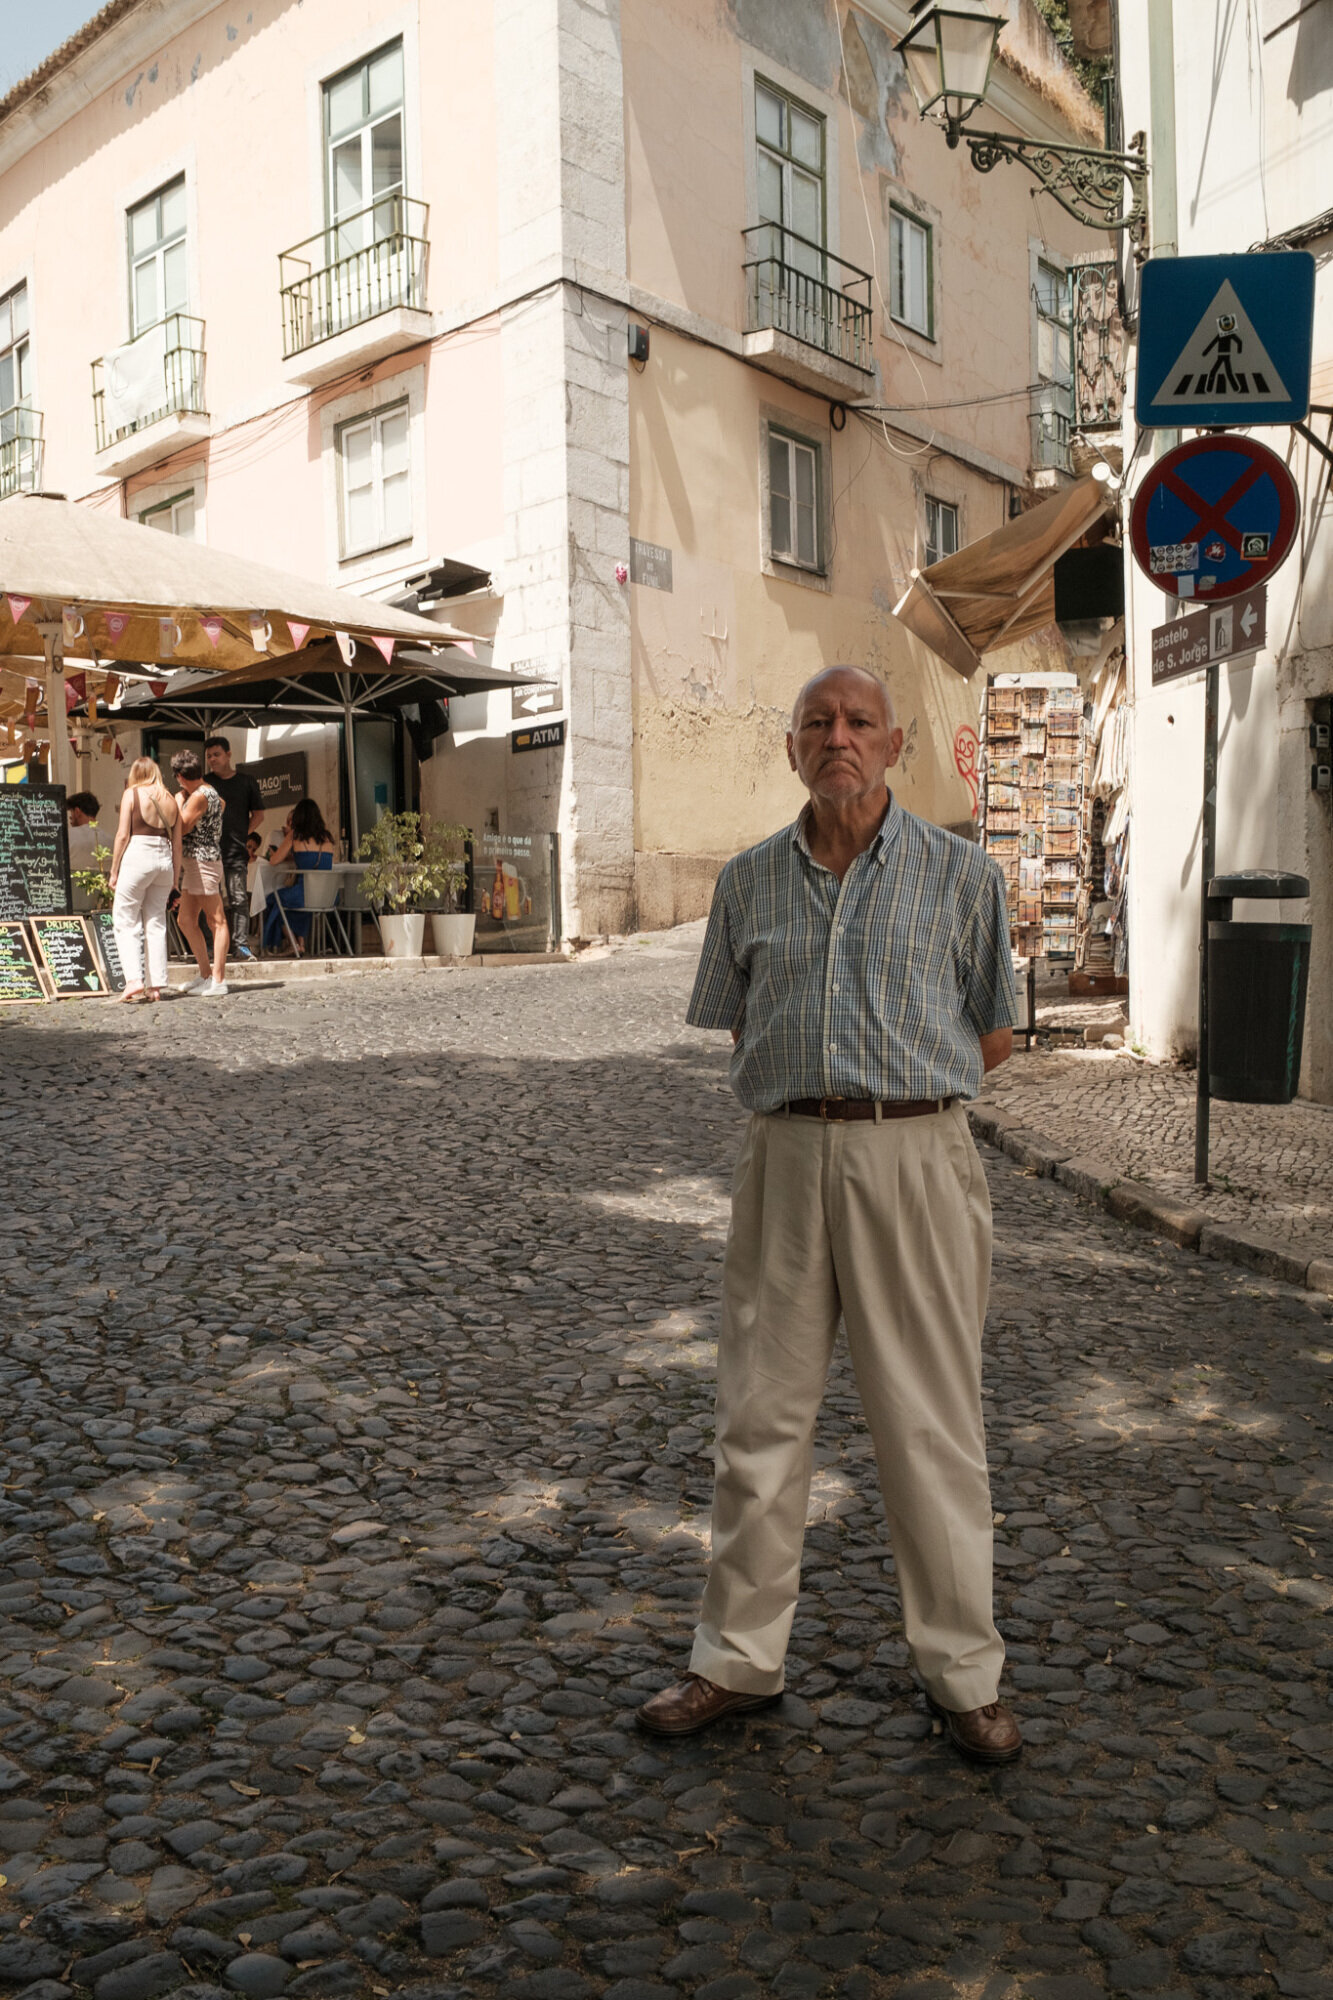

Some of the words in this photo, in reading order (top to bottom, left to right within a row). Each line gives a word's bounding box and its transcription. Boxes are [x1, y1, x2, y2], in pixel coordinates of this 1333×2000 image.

[634, 542, 667, 561] TRAVESSA
[1153, 626, 1189, 651] castelo
[1153, 659, 1164, 674] de
[1167, 652, 1177, 669] S.
[1179, 644, 1208, 664] Jorge
[532, 727, 560, 745] ATM
[46, 921, 80, 931] DRINKS
